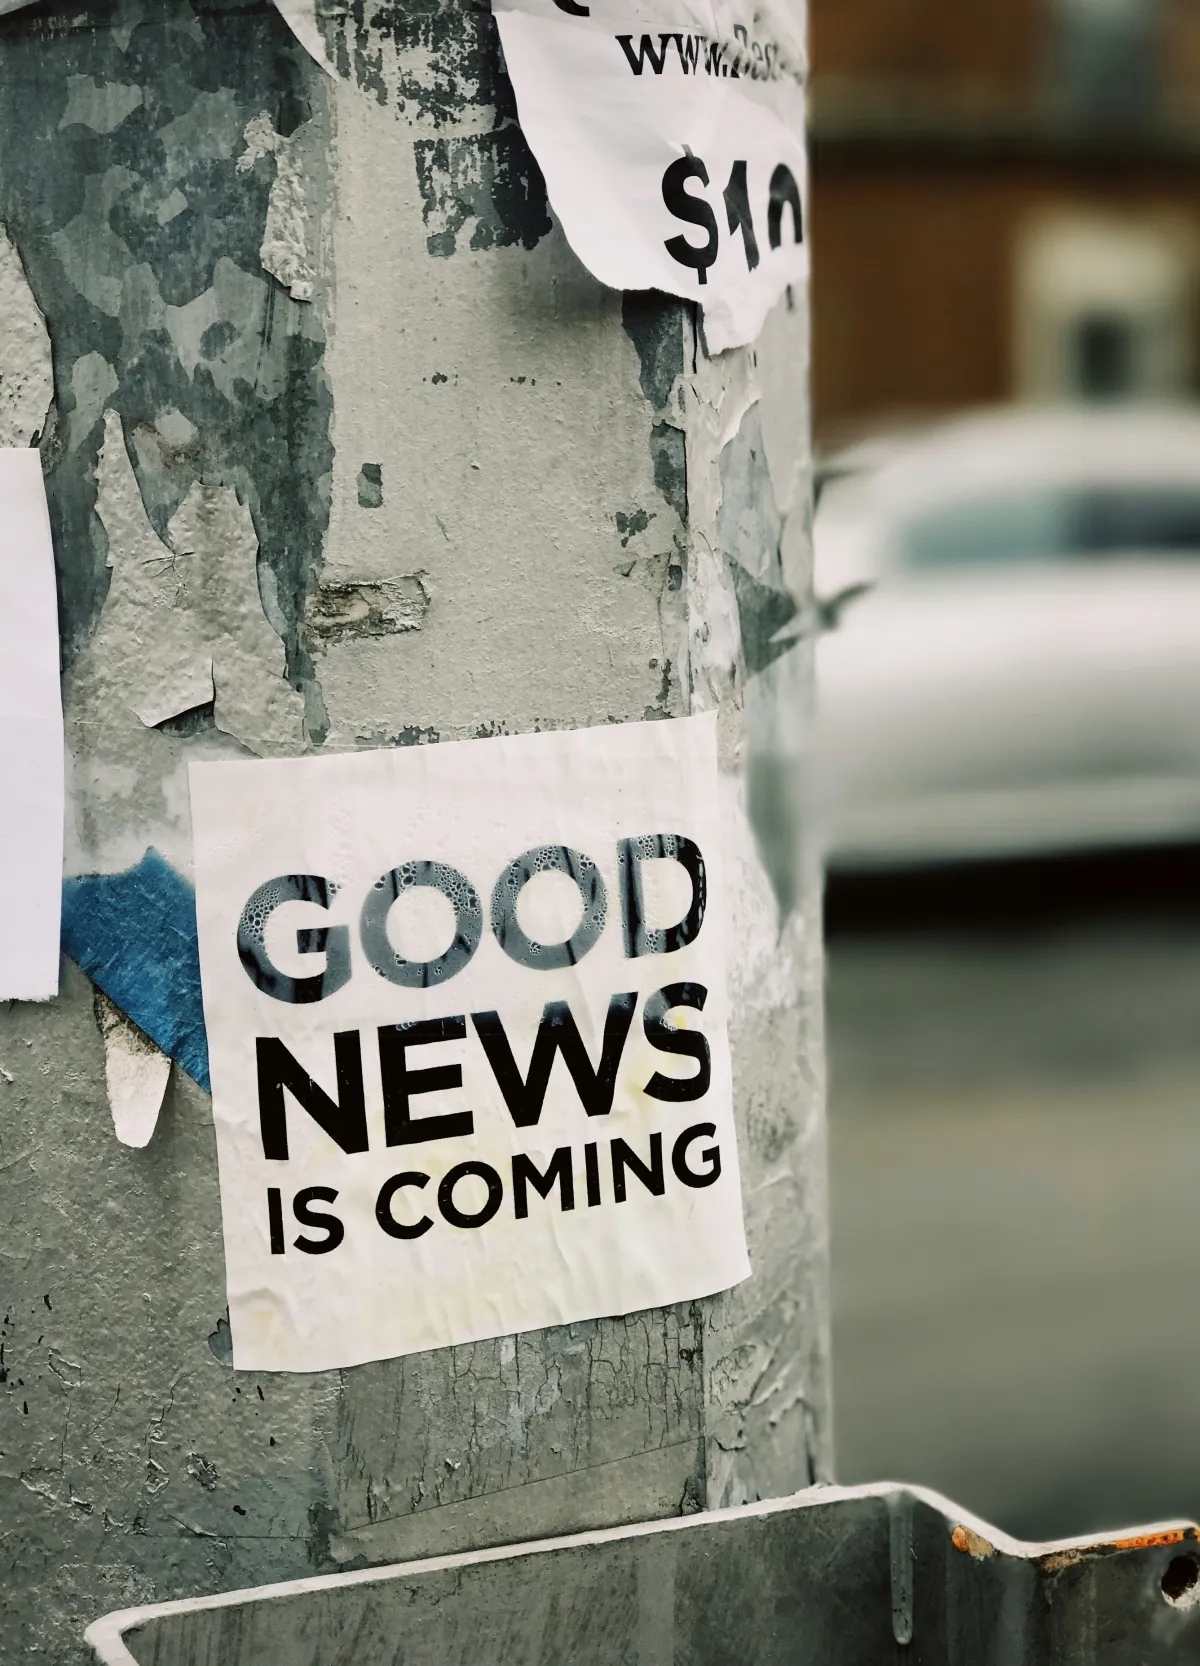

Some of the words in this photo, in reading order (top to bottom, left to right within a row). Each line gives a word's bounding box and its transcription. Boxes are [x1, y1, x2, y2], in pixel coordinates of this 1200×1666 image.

[237, 833, 708, 1004] GOOD
[255, 981, 712, 1161] NEWS
[267, 1186, 345, 1255] IS
[375, 1122, 722, 1240] COMING
